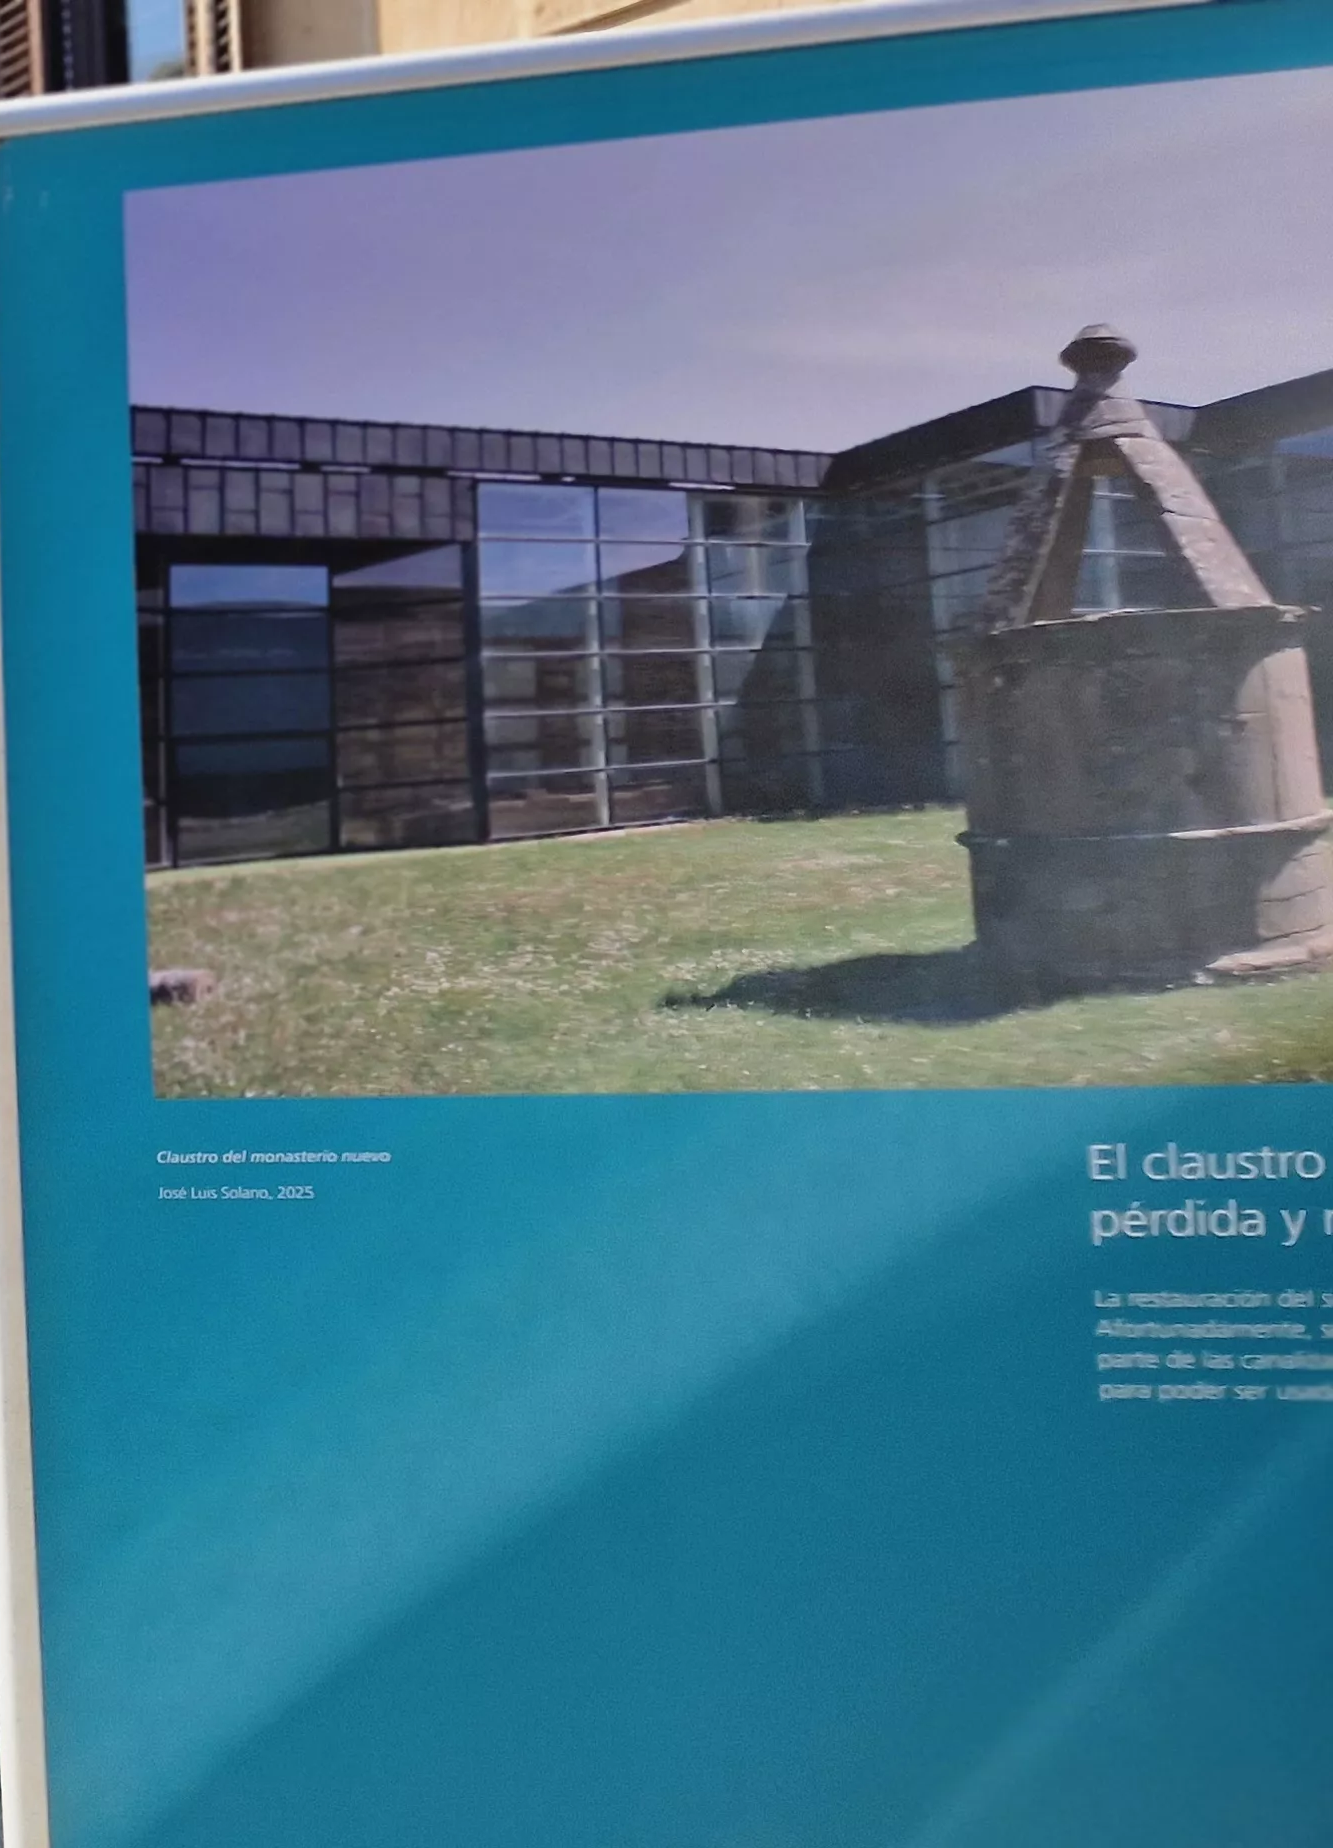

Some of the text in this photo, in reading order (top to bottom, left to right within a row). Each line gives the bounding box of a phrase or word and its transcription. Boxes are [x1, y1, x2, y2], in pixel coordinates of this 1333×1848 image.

[157, 1150, 391, 1164] Claustro del monasterio nuevo
[1089, 1142, 1326, 1180] El claustro
[158, 1186, 315, 1200] José Luis Solano, 2025
[1091, 1199, 1267, 1246] pérdida
[1279, 1209, 1307, 1246] y
[1094, 1290, 1121, 1307] La
[1278, 1288, 1314, 1307] del
[1166, 1350, 1196, 1369] de
